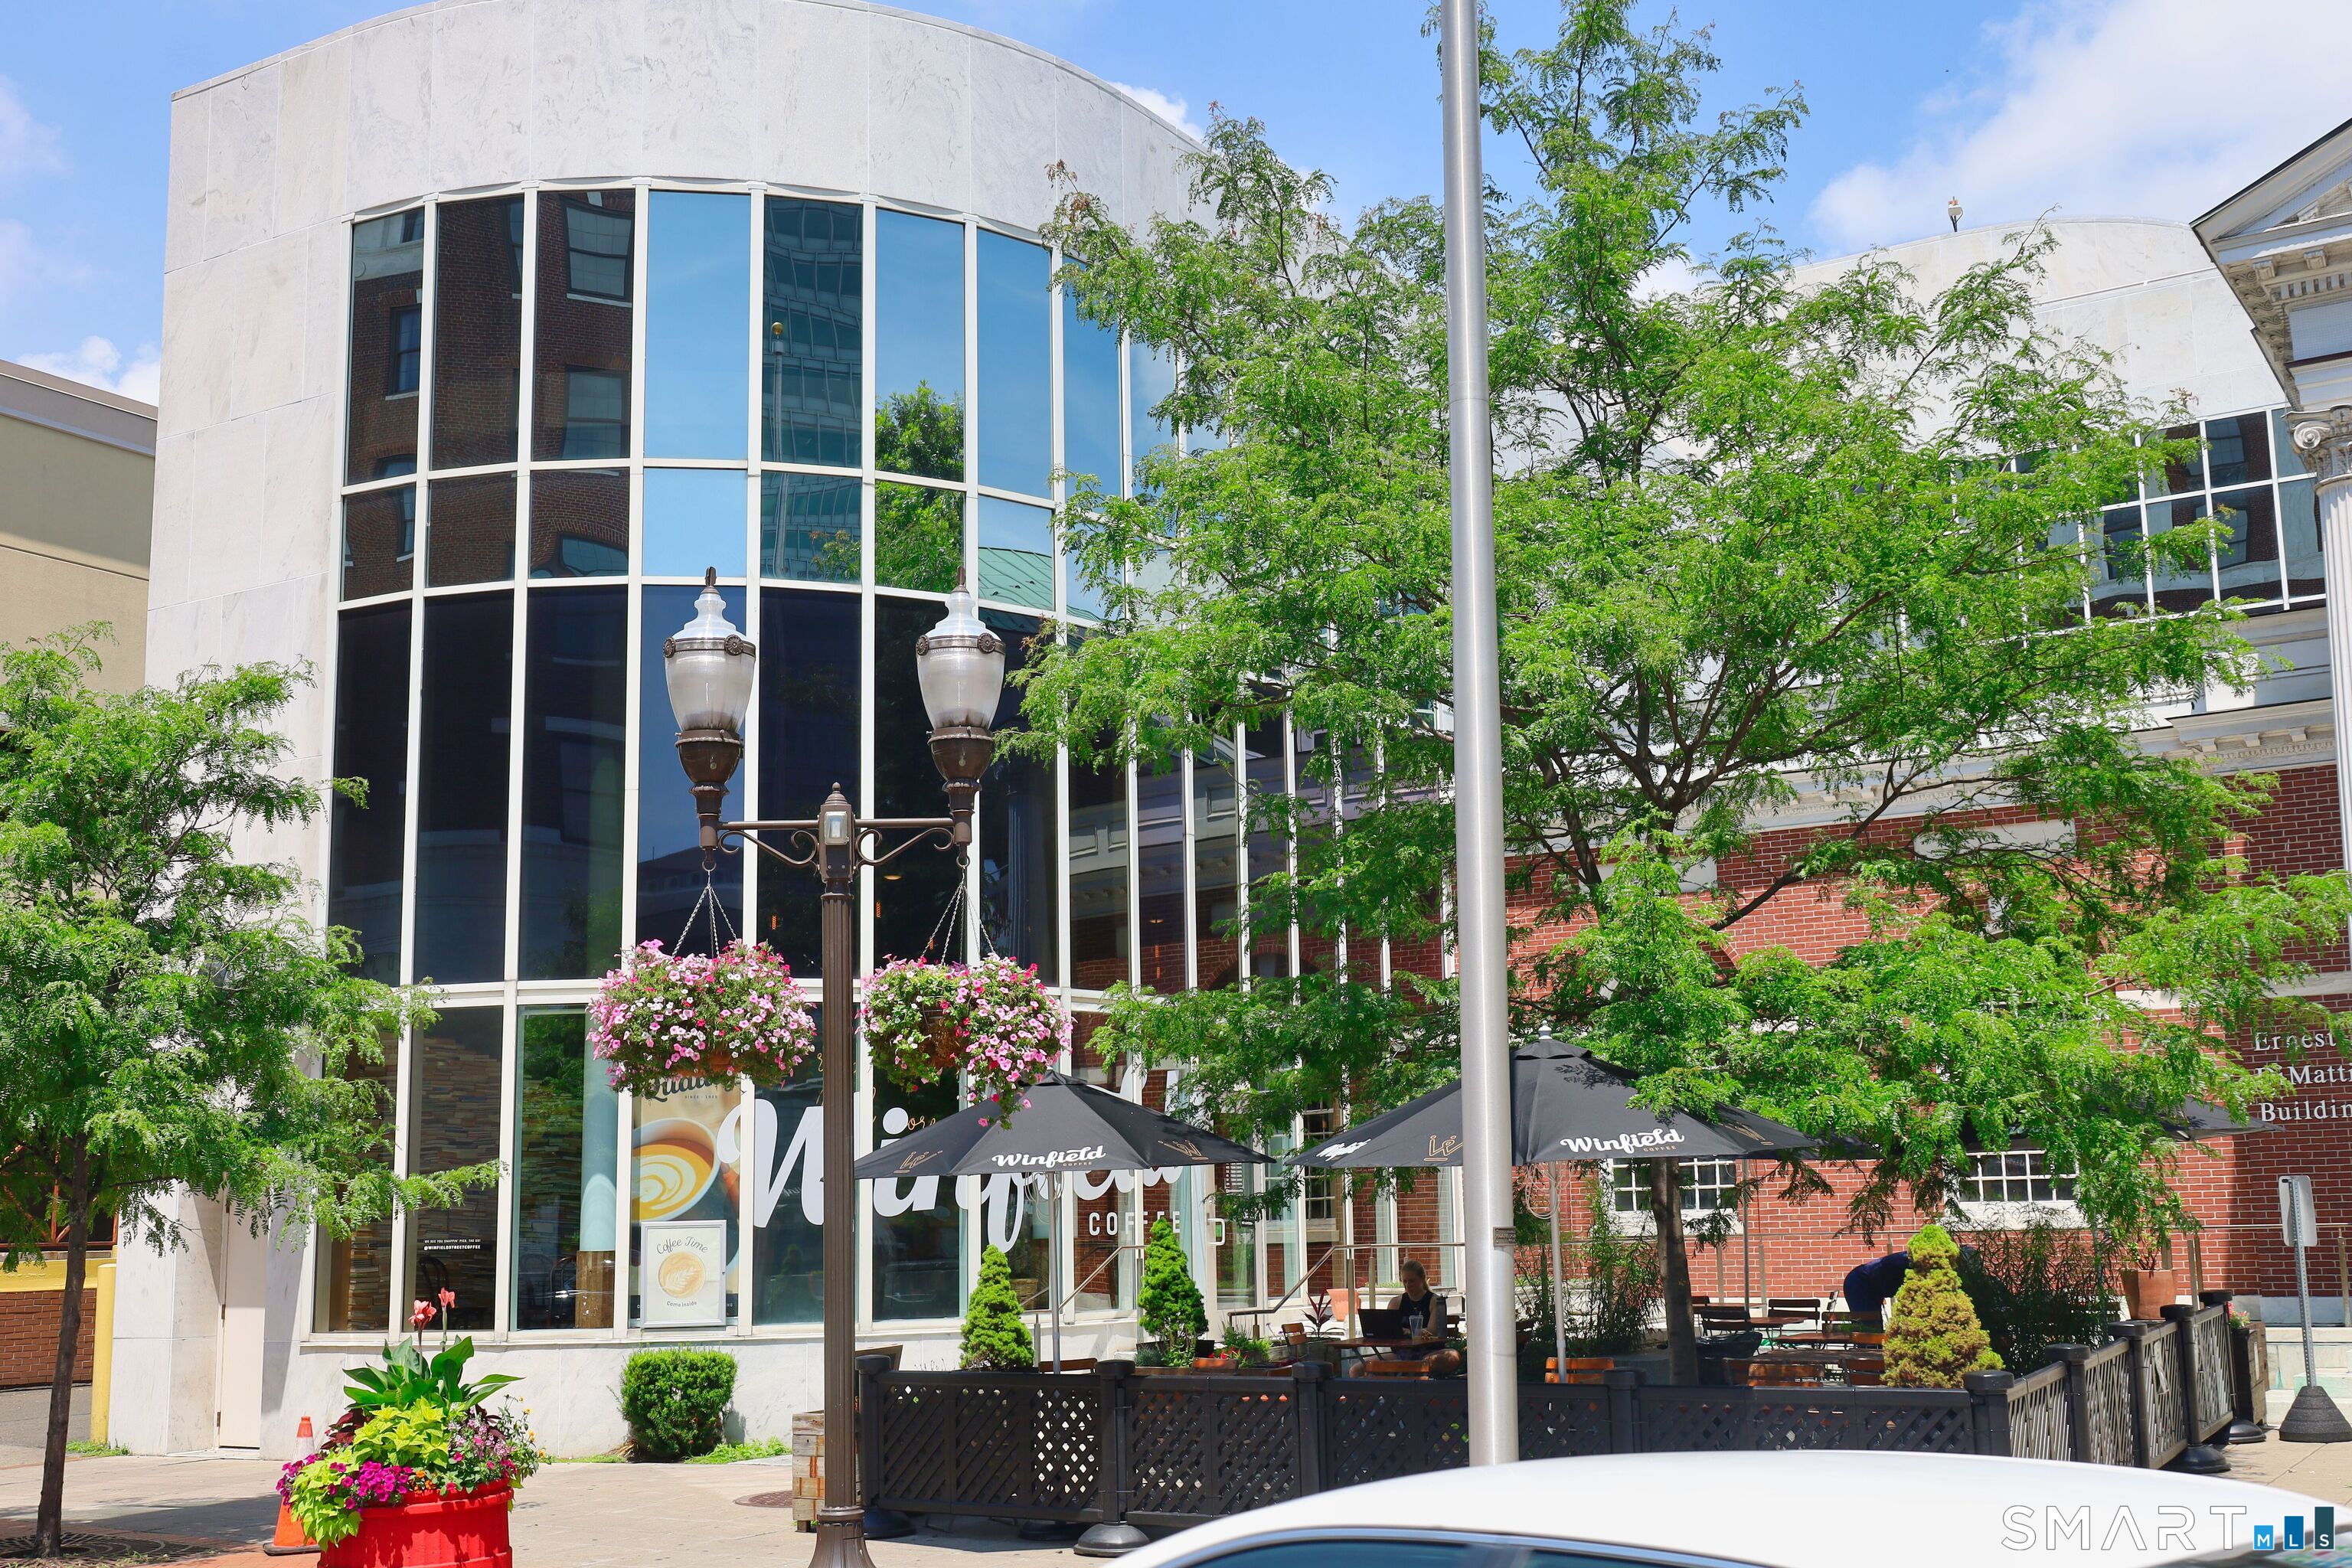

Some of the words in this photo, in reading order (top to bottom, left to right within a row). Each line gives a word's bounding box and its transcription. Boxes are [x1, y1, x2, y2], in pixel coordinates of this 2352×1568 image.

[2255, 1063, 2352, 1085] Matti
[1560, 1128, 1685, 1154] Winfield
[991, 1145, 1106, 1168] Winfield
[1089, 1211, 1181, 1236] COFE
[657, 1238, 682, 1254] Coffee
[685, 1236, 708, 1253] Time
